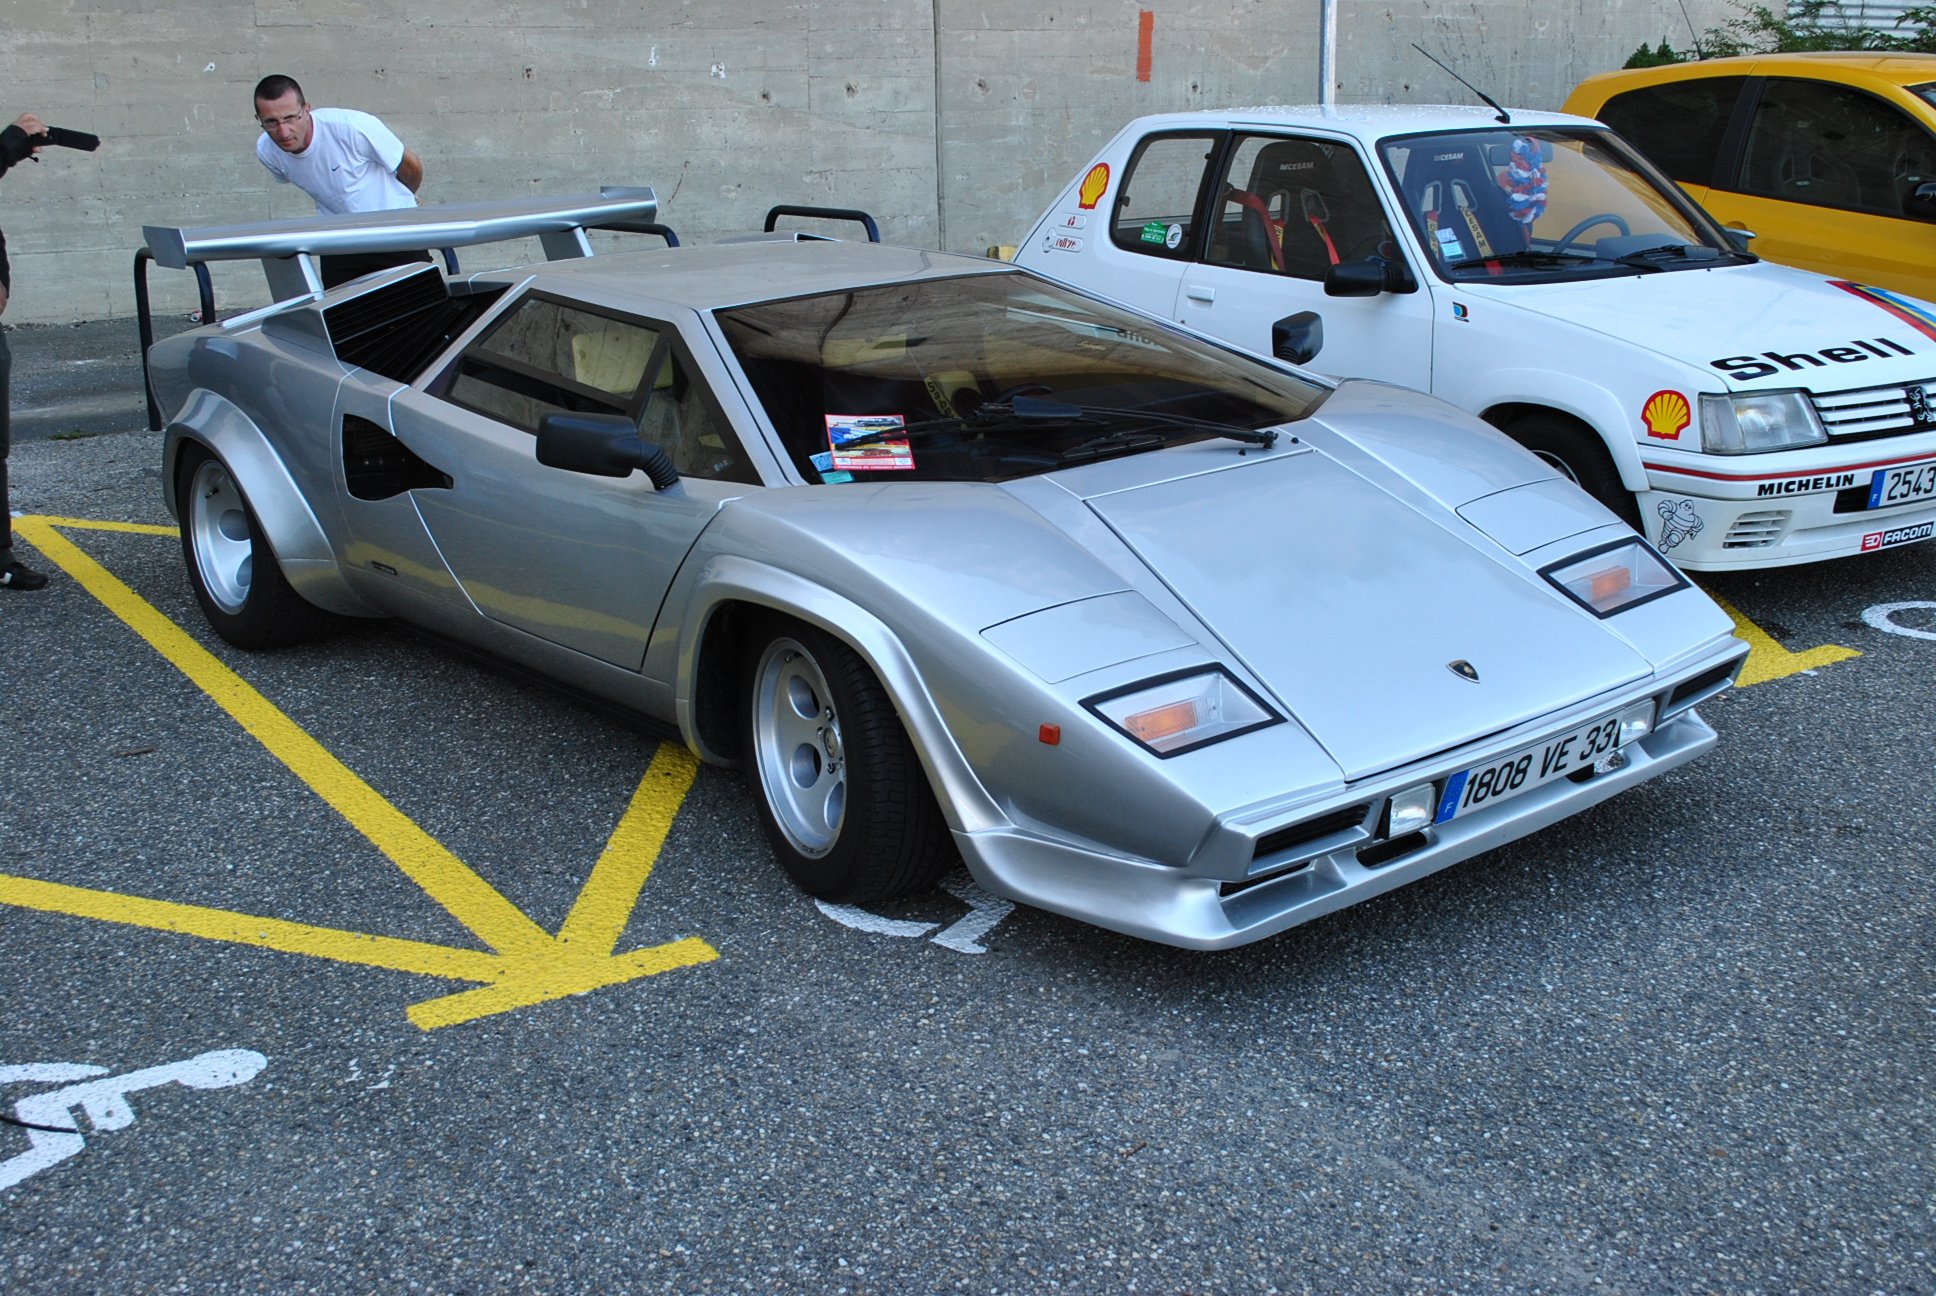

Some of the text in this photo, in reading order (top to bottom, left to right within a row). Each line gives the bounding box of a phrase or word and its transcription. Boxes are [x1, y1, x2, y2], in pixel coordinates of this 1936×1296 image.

[1710, 337, 1916, 381] Shell
[1757, 474, 1855, 496] MICHELIN
[1887, 466, 1936, 501] 2543
[1883, 525, 1932, 544] FACOM
[1444, 802, 1454, 814] F
[1462, 754, 1533, 809] 1808
[1540, 735, 1578, 779] VE
